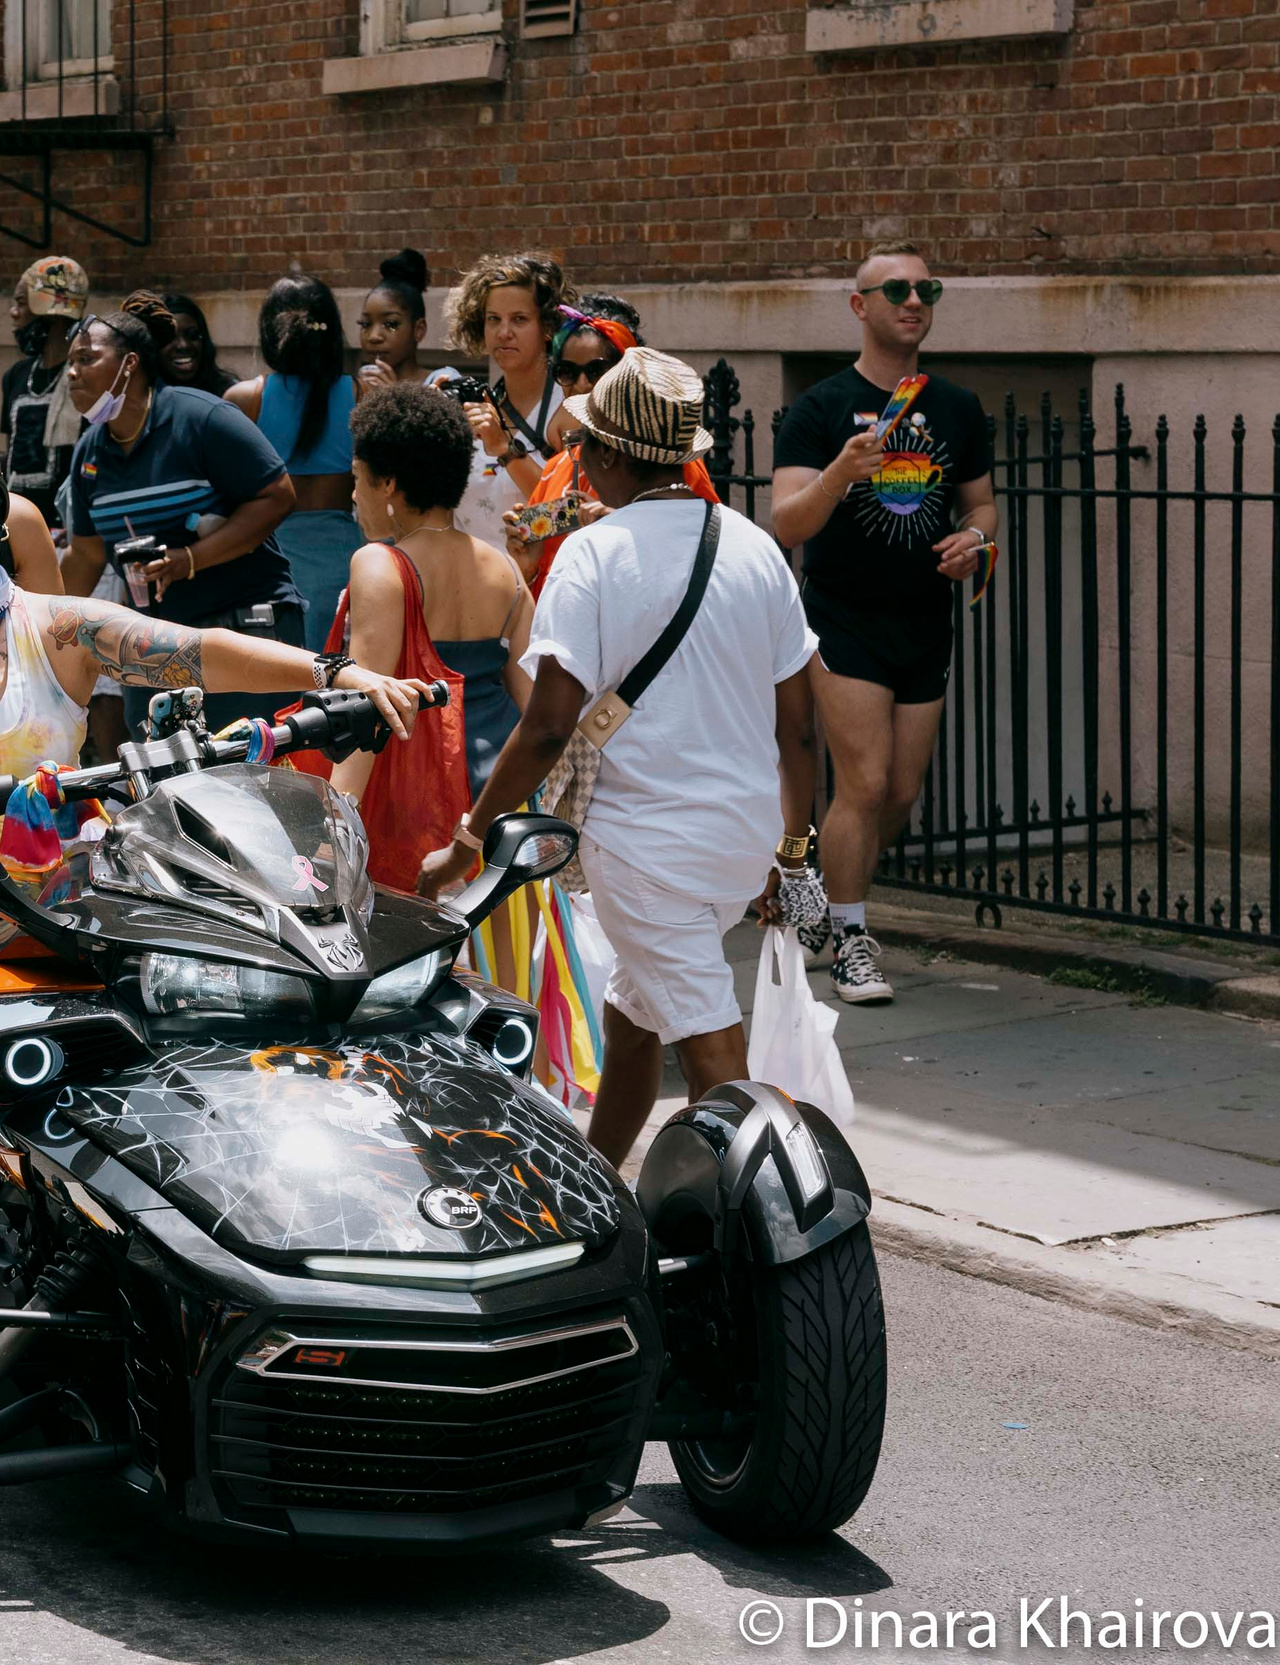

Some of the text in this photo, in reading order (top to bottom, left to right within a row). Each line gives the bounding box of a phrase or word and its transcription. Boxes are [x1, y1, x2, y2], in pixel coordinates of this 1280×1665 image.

[883, 476, 918, 486] COFFEE
[891, 485, 912, 494] BOX
[451, 1206, 477, 1215] BRP
